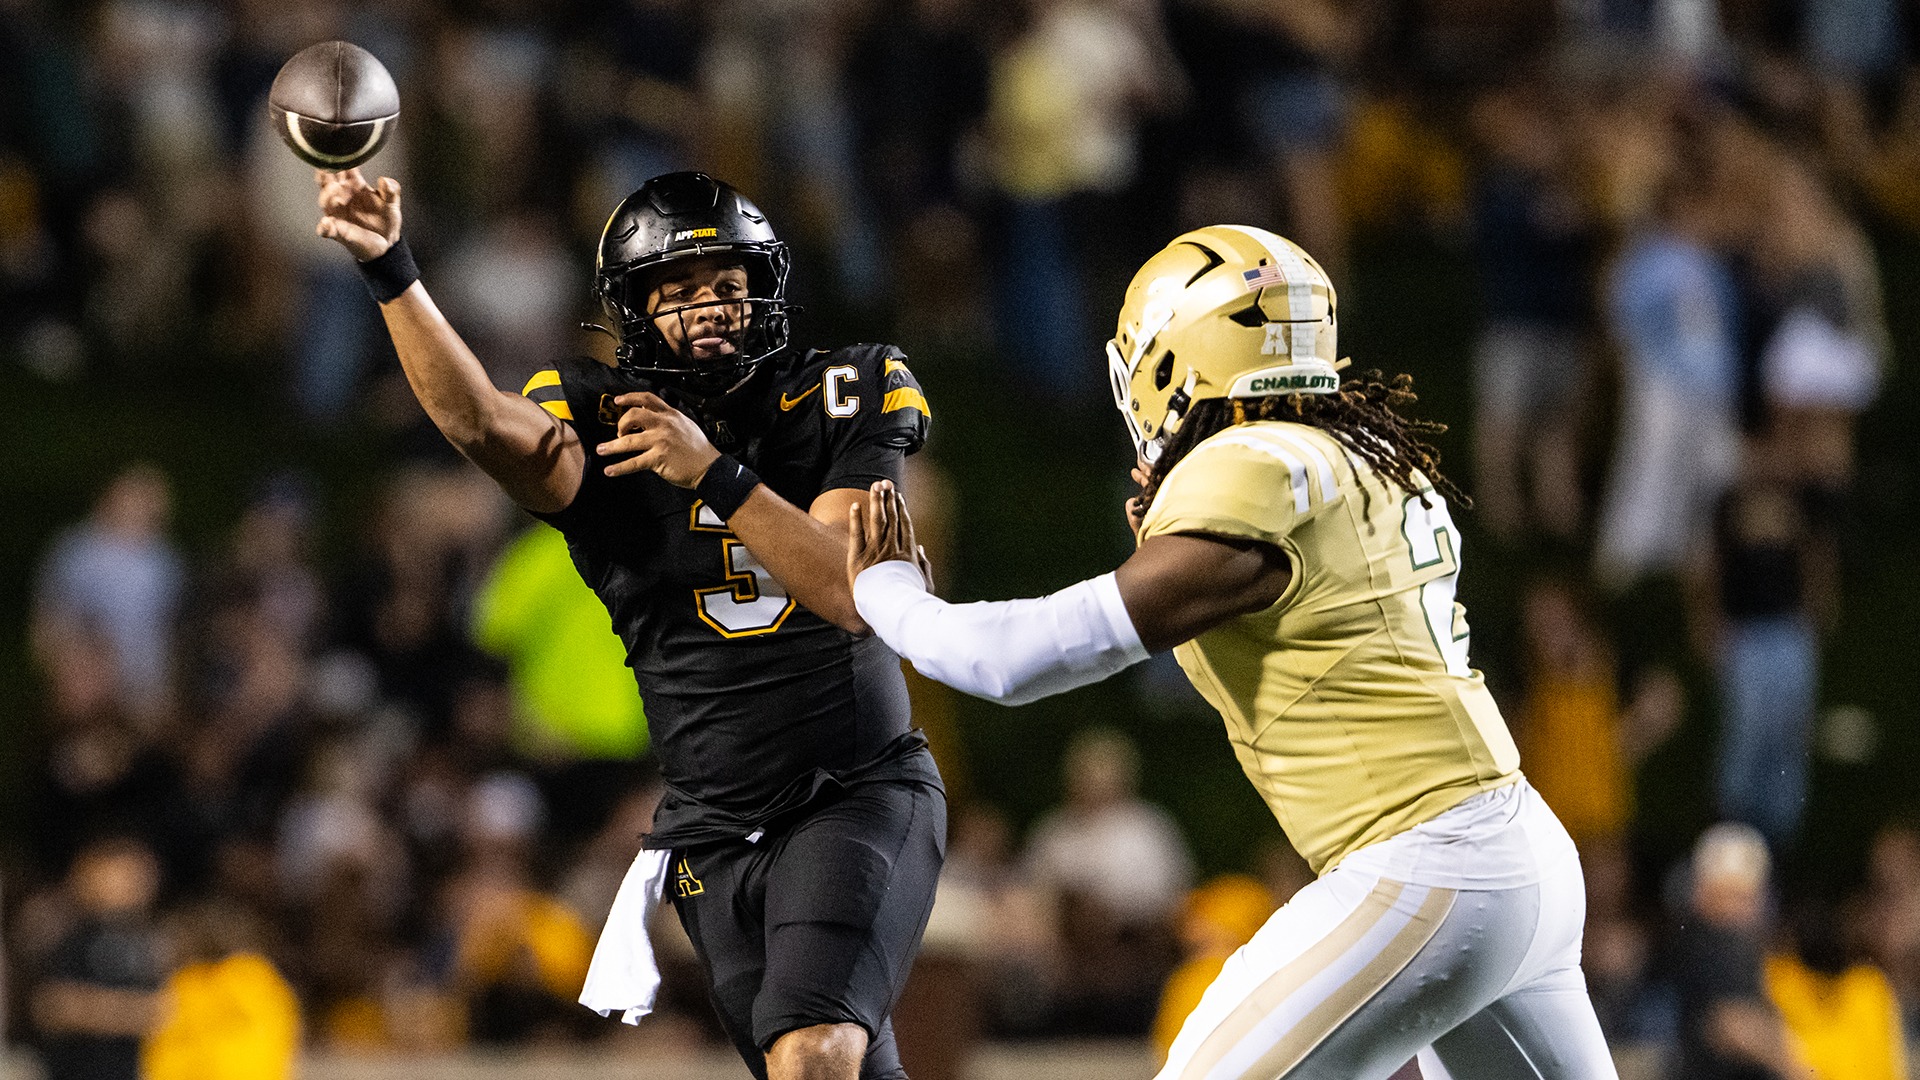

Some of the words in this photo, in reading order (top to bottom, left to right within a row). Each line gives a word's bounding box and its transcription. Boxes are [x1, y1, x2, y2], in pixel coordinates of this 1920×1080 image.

[674, 227, 718, 241] APPSTATE
[822, 364, 860, 419] C
[1250, 374, 1337, 393] CHARLOTTE
[689, 498, 797, 639] 3
